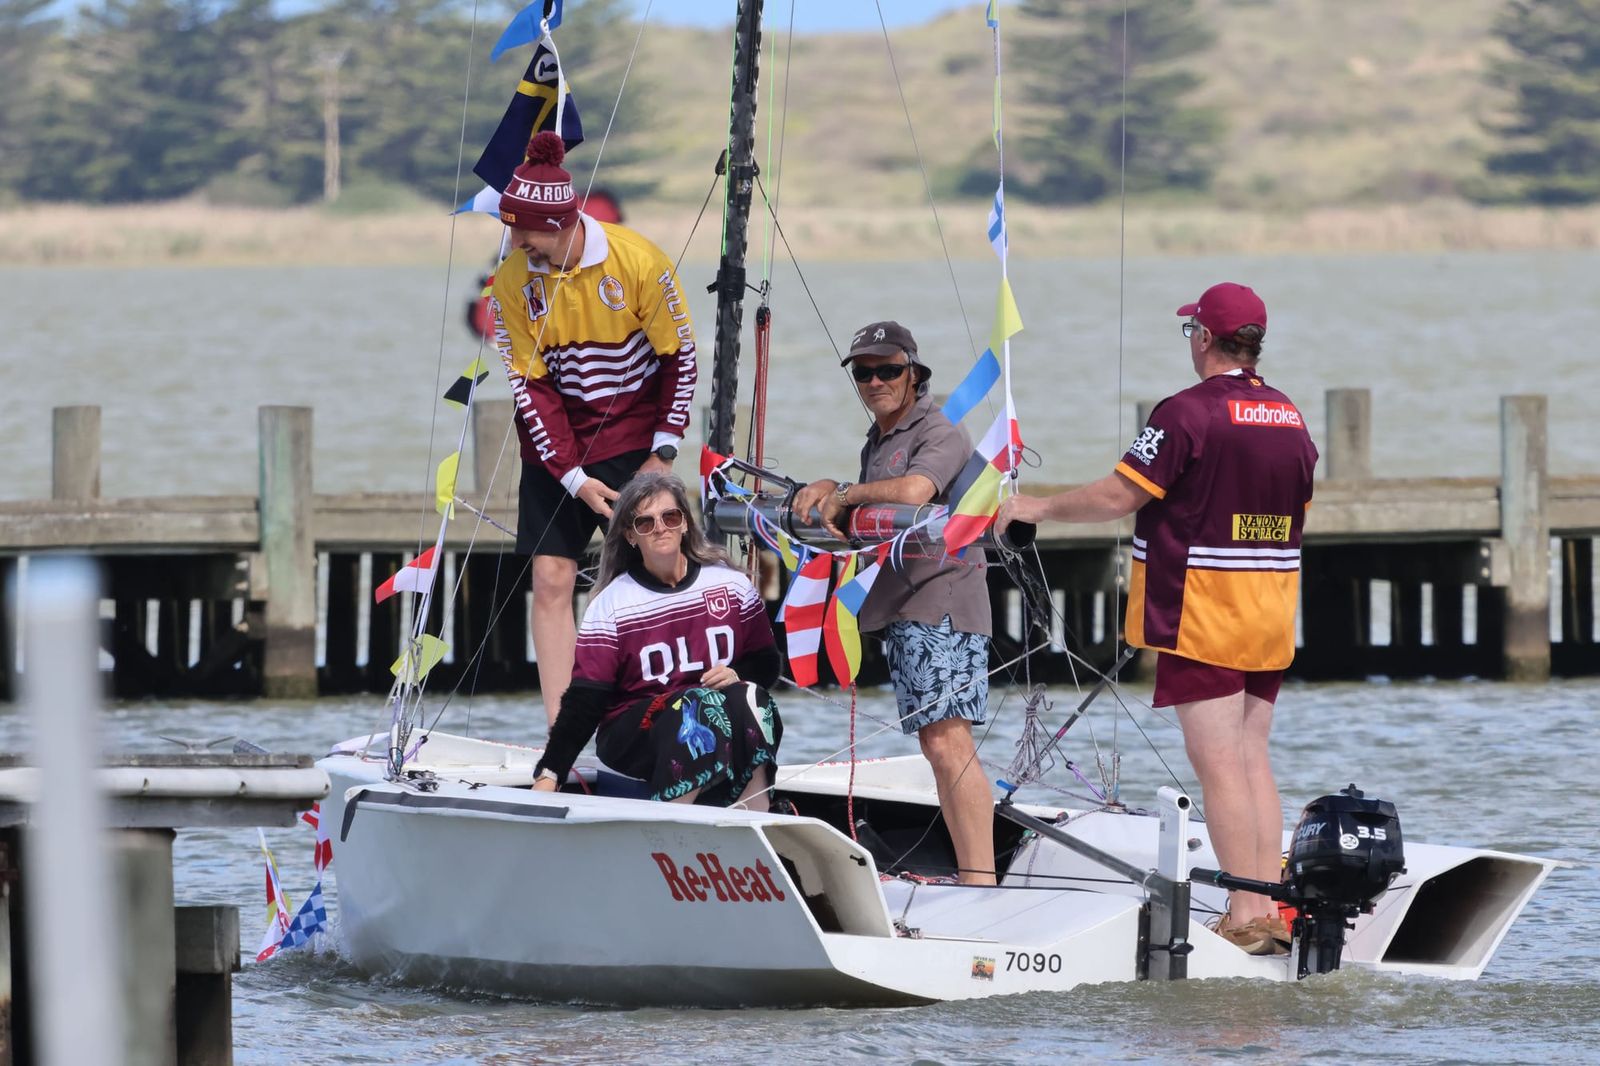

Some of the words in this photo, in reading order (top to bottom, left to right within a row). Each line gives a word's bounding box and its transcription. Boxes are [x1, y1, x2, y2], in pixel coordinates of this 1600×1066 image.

[666, 352, 698, 428] MANGO
[1235, 402, 1301, 426] Ladbrokes
[639, 624, 735, 685] QLD
[1357, 825, 1387, 841] 3.5
[651, 852, 786, 902] Re-Heat
[1005, 951, 1062, 974] 7090
